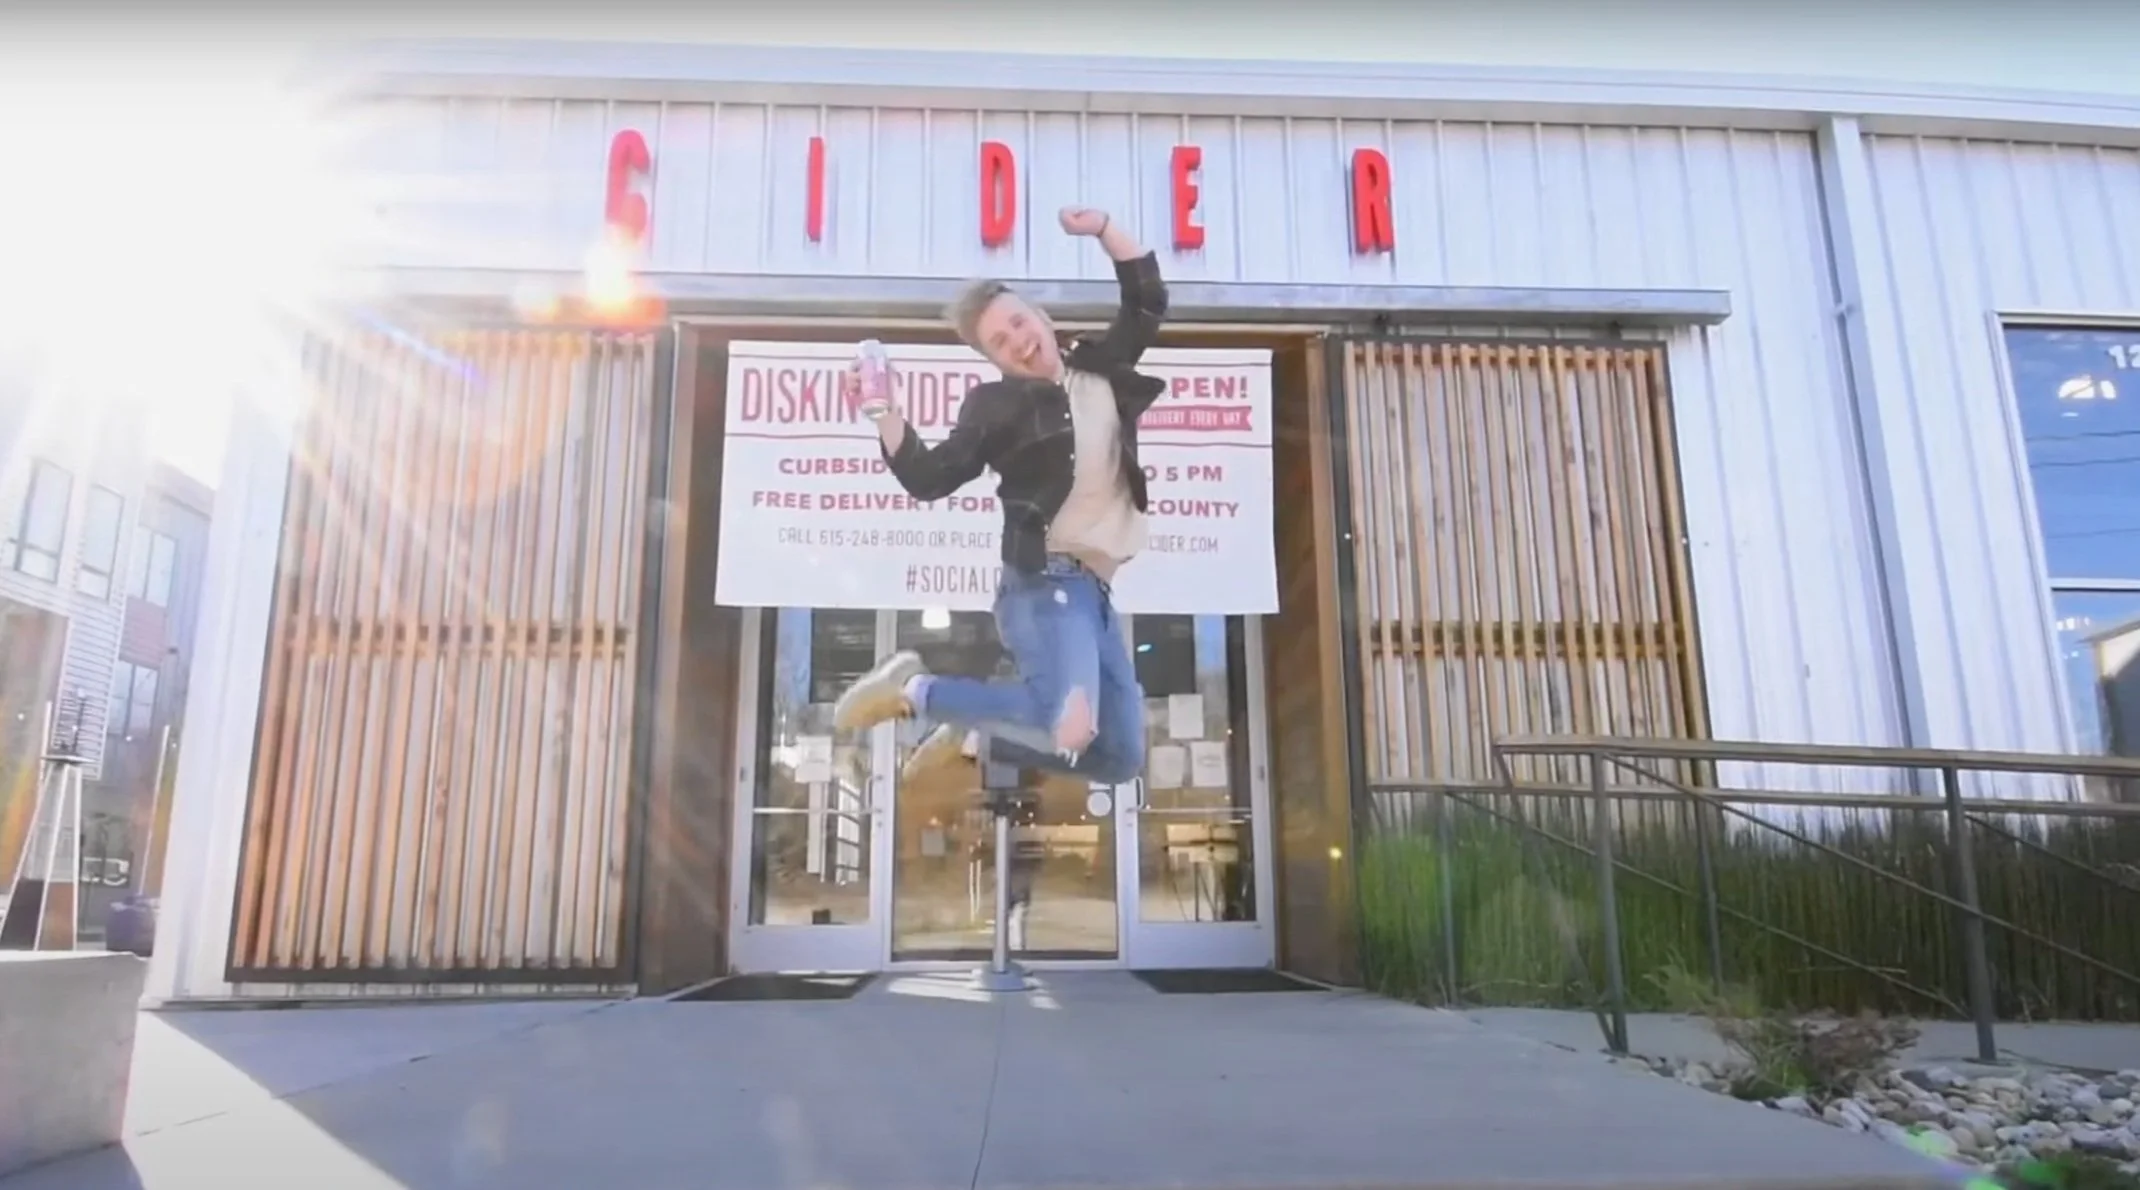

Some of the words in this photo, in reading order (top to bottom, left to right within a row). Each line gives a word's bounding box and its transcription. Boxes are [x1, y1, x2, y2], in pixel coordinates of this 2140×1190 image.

[605, 128, 1395, 253] CIDER
[895, 370, 982, 427] IDE
[1171, 376, 1248, 399] PEN!
[778, 457, 887, 475] CURBSID
[1142, 465, 1158, 482] O
[1165, 466, 1179, 482] 5
[1187, 465, 1222, 482] PM
[753, 491, 811, 511] FREE
[947, 496, 996, 513] FOR
[778, 527, 813, 545] CALL
[818, 528, 924, 547] 615-248-8000
[928, 530, 947, 548] OR
[950, 531, 993, 549] PLACE
